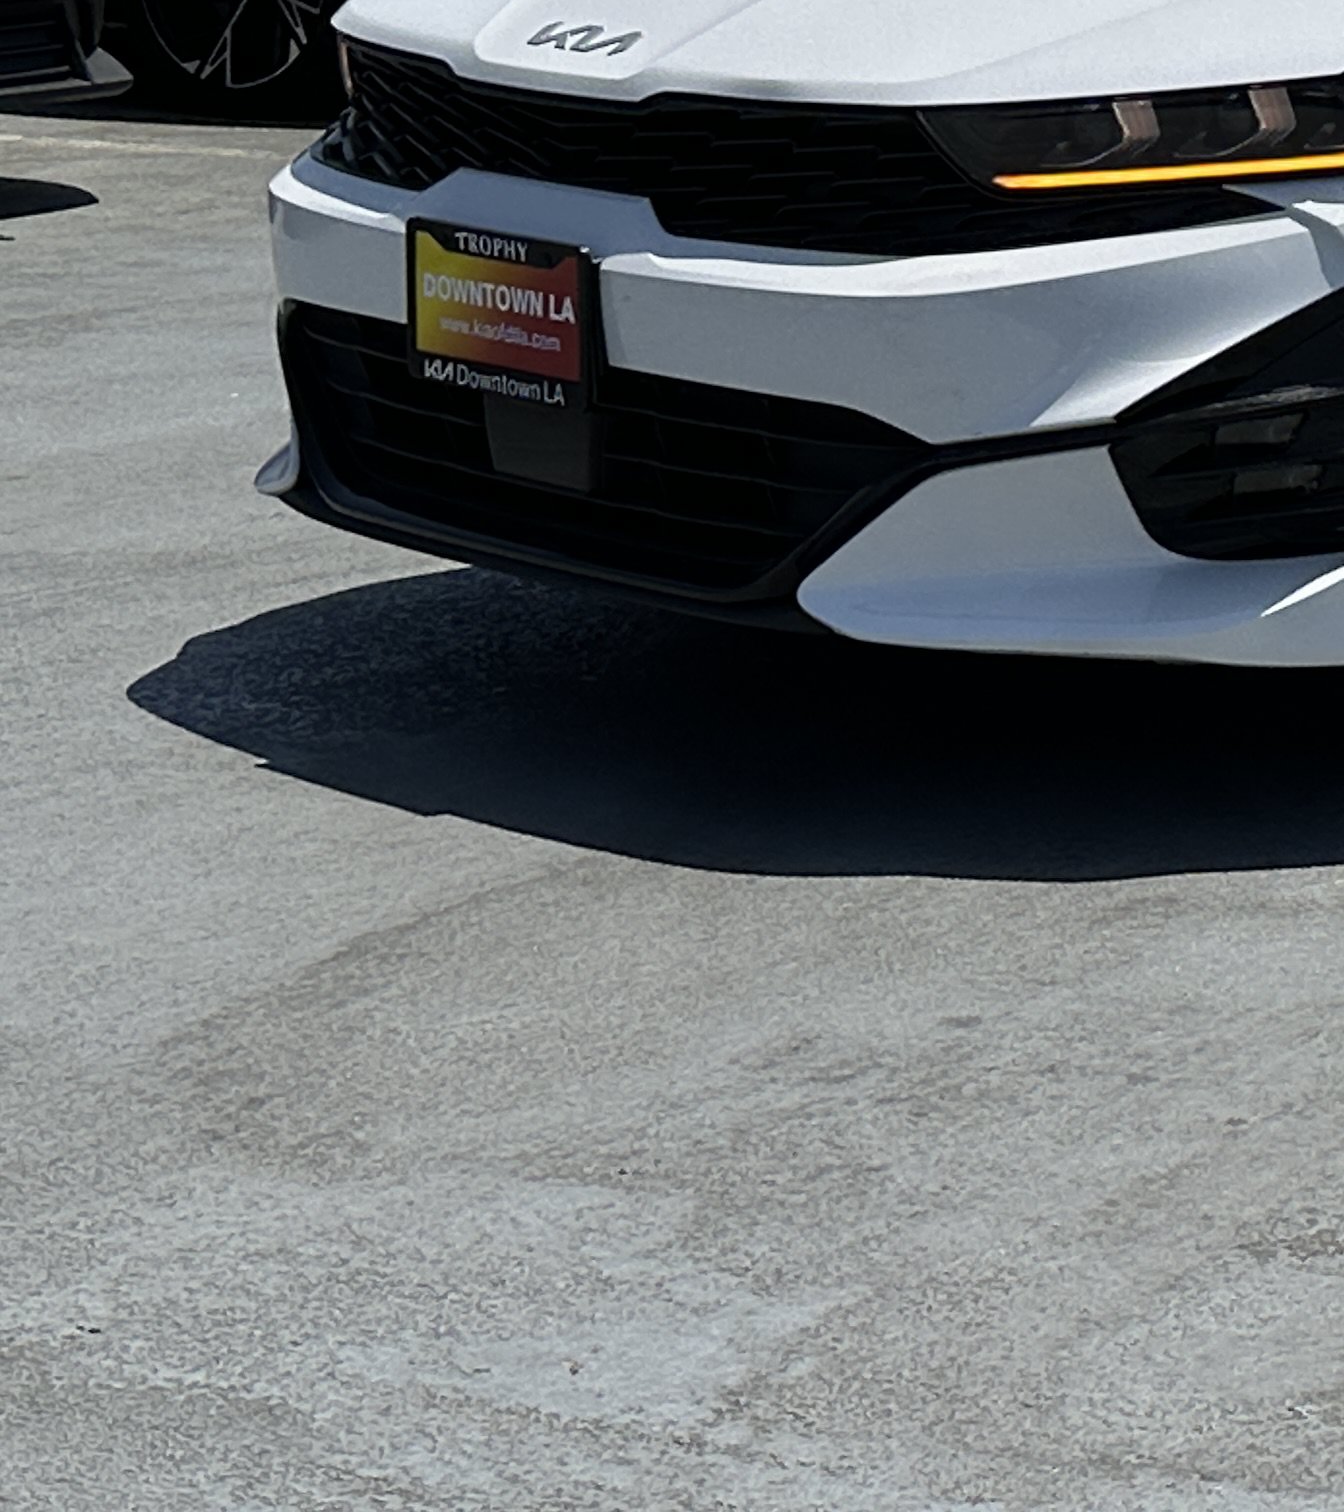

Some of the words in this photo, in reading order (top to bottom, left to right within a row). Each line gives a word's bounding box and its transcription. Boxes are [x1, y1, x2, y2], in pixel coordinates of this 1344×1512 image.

[454, 231, 528, 263] TROPHY
[422, 272, 544, 318] DOWNTOWN
[549, 292, 576, 325] LA
[456, 363, 541, 401] Downtown
[543, 380, 566, 407] LA
